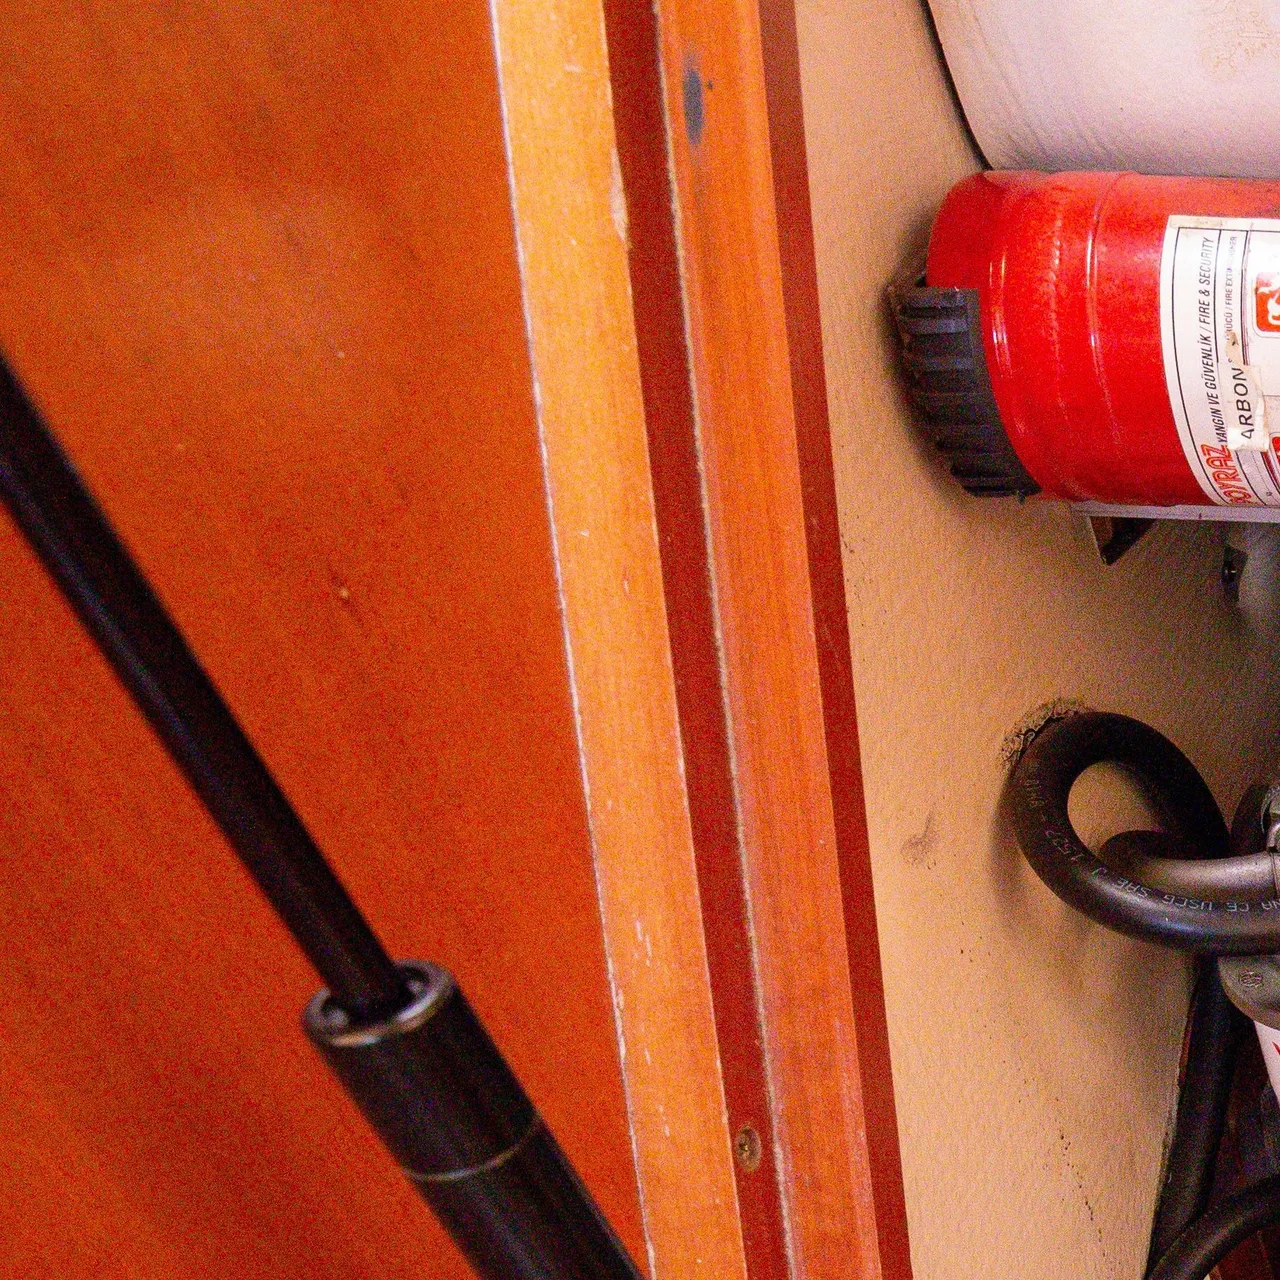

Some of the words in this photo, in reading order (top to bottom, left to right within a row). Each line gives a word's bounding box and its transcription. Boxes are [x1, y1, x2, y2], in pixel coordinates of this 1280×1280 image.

[1199, 237, 1213, 285] SECURITY
[1199, 300, 1211, 325] FIRE
[1198, 334, 1216, 390] GÜVENLİK
[1207, 392, 1219, 405] VE
[1210, 408, 1227, 443] YANGIN
